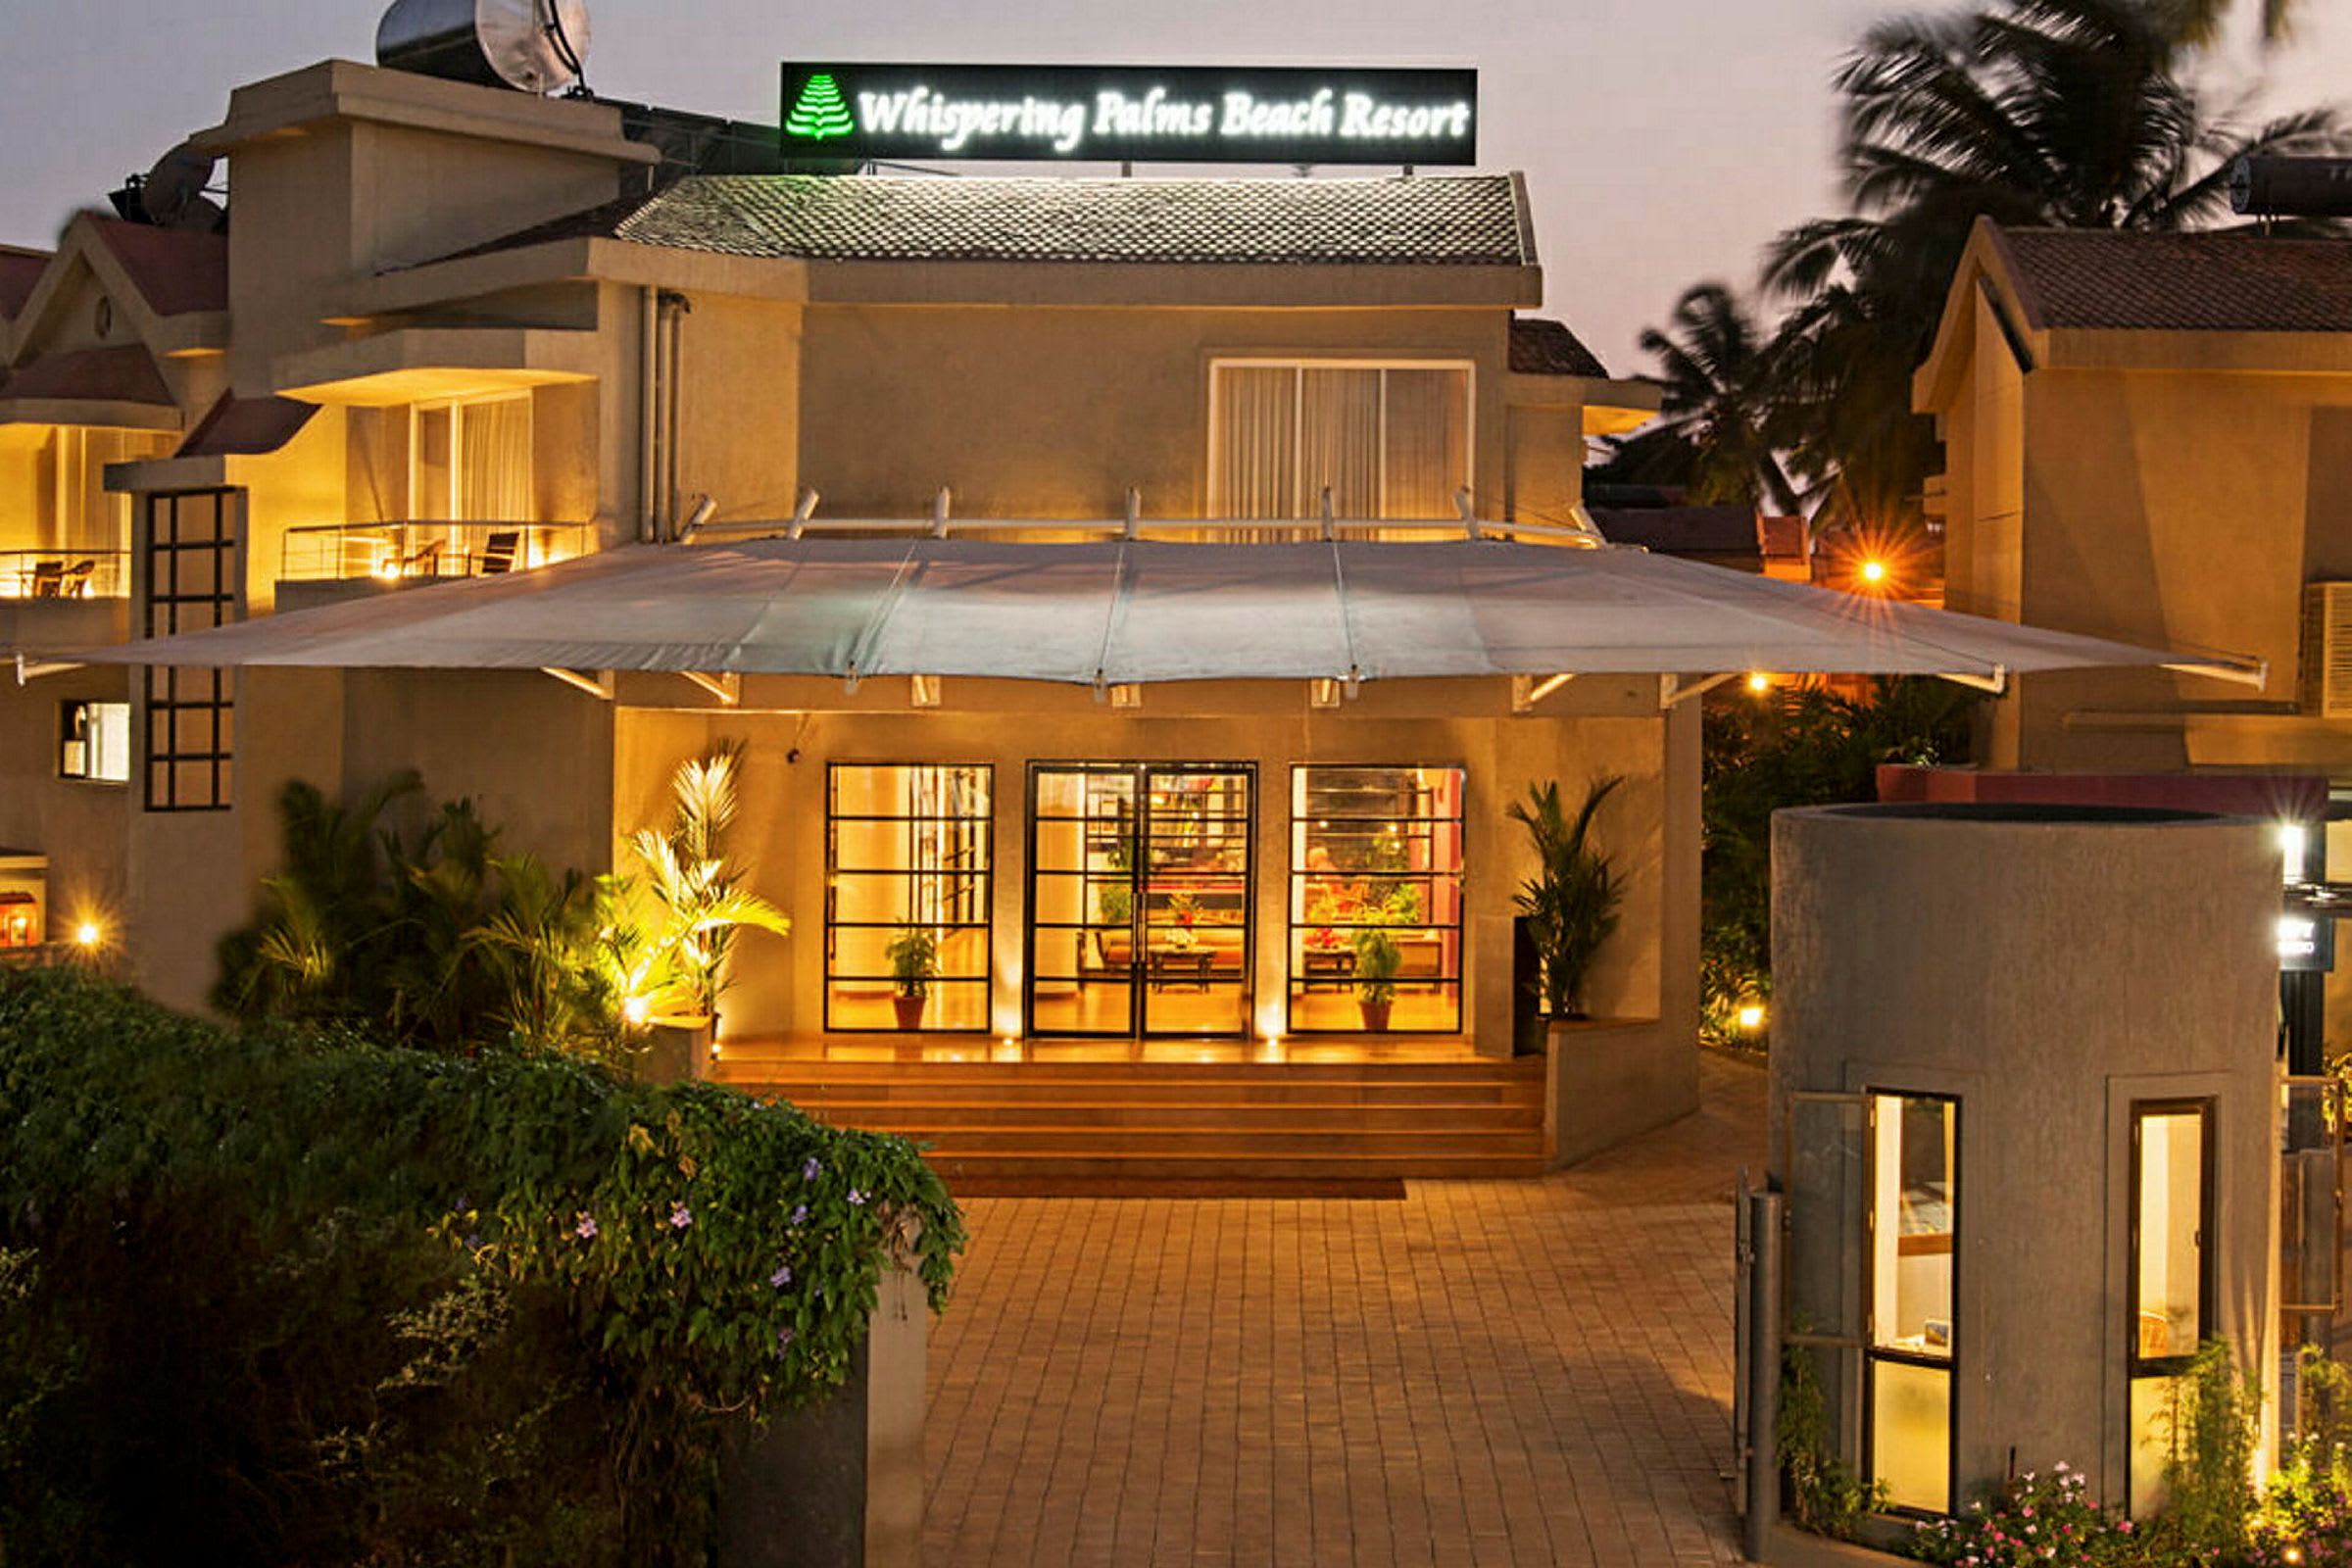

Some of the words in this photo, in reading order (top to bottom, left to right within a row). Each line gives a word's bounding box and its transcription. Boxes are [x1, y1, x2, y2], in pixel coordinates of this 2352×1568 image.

[858, 85, 1086, 152] Whispering
[1091, 86, 1212, 135] Palms
[1219, 87, 1334, 136] Beach
[1339, 91, 1469, 138] Resort
